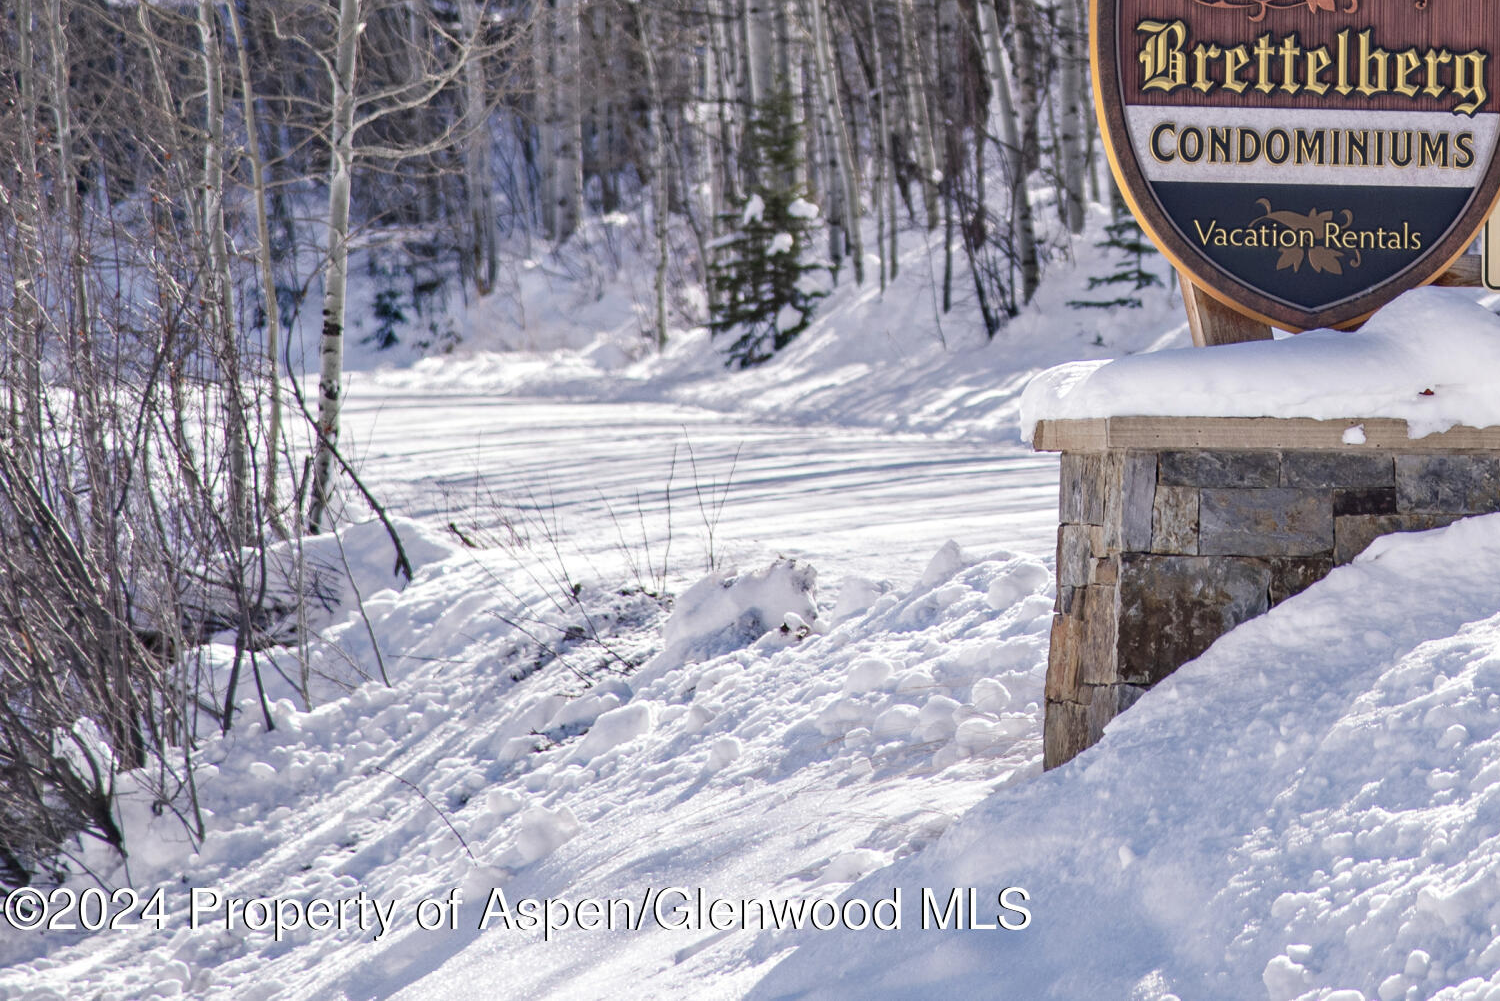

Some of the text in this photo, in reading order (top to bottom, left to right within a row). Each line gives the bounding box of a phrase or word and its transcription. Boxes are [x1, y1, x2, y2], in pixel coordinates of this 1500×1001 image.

[1136, 19, 1489, 116] Brettelberg
[1149, 121, 1477, 171] CONDOMINIUMS
[1193, 219, 1422, 251] Vacation Rentals
